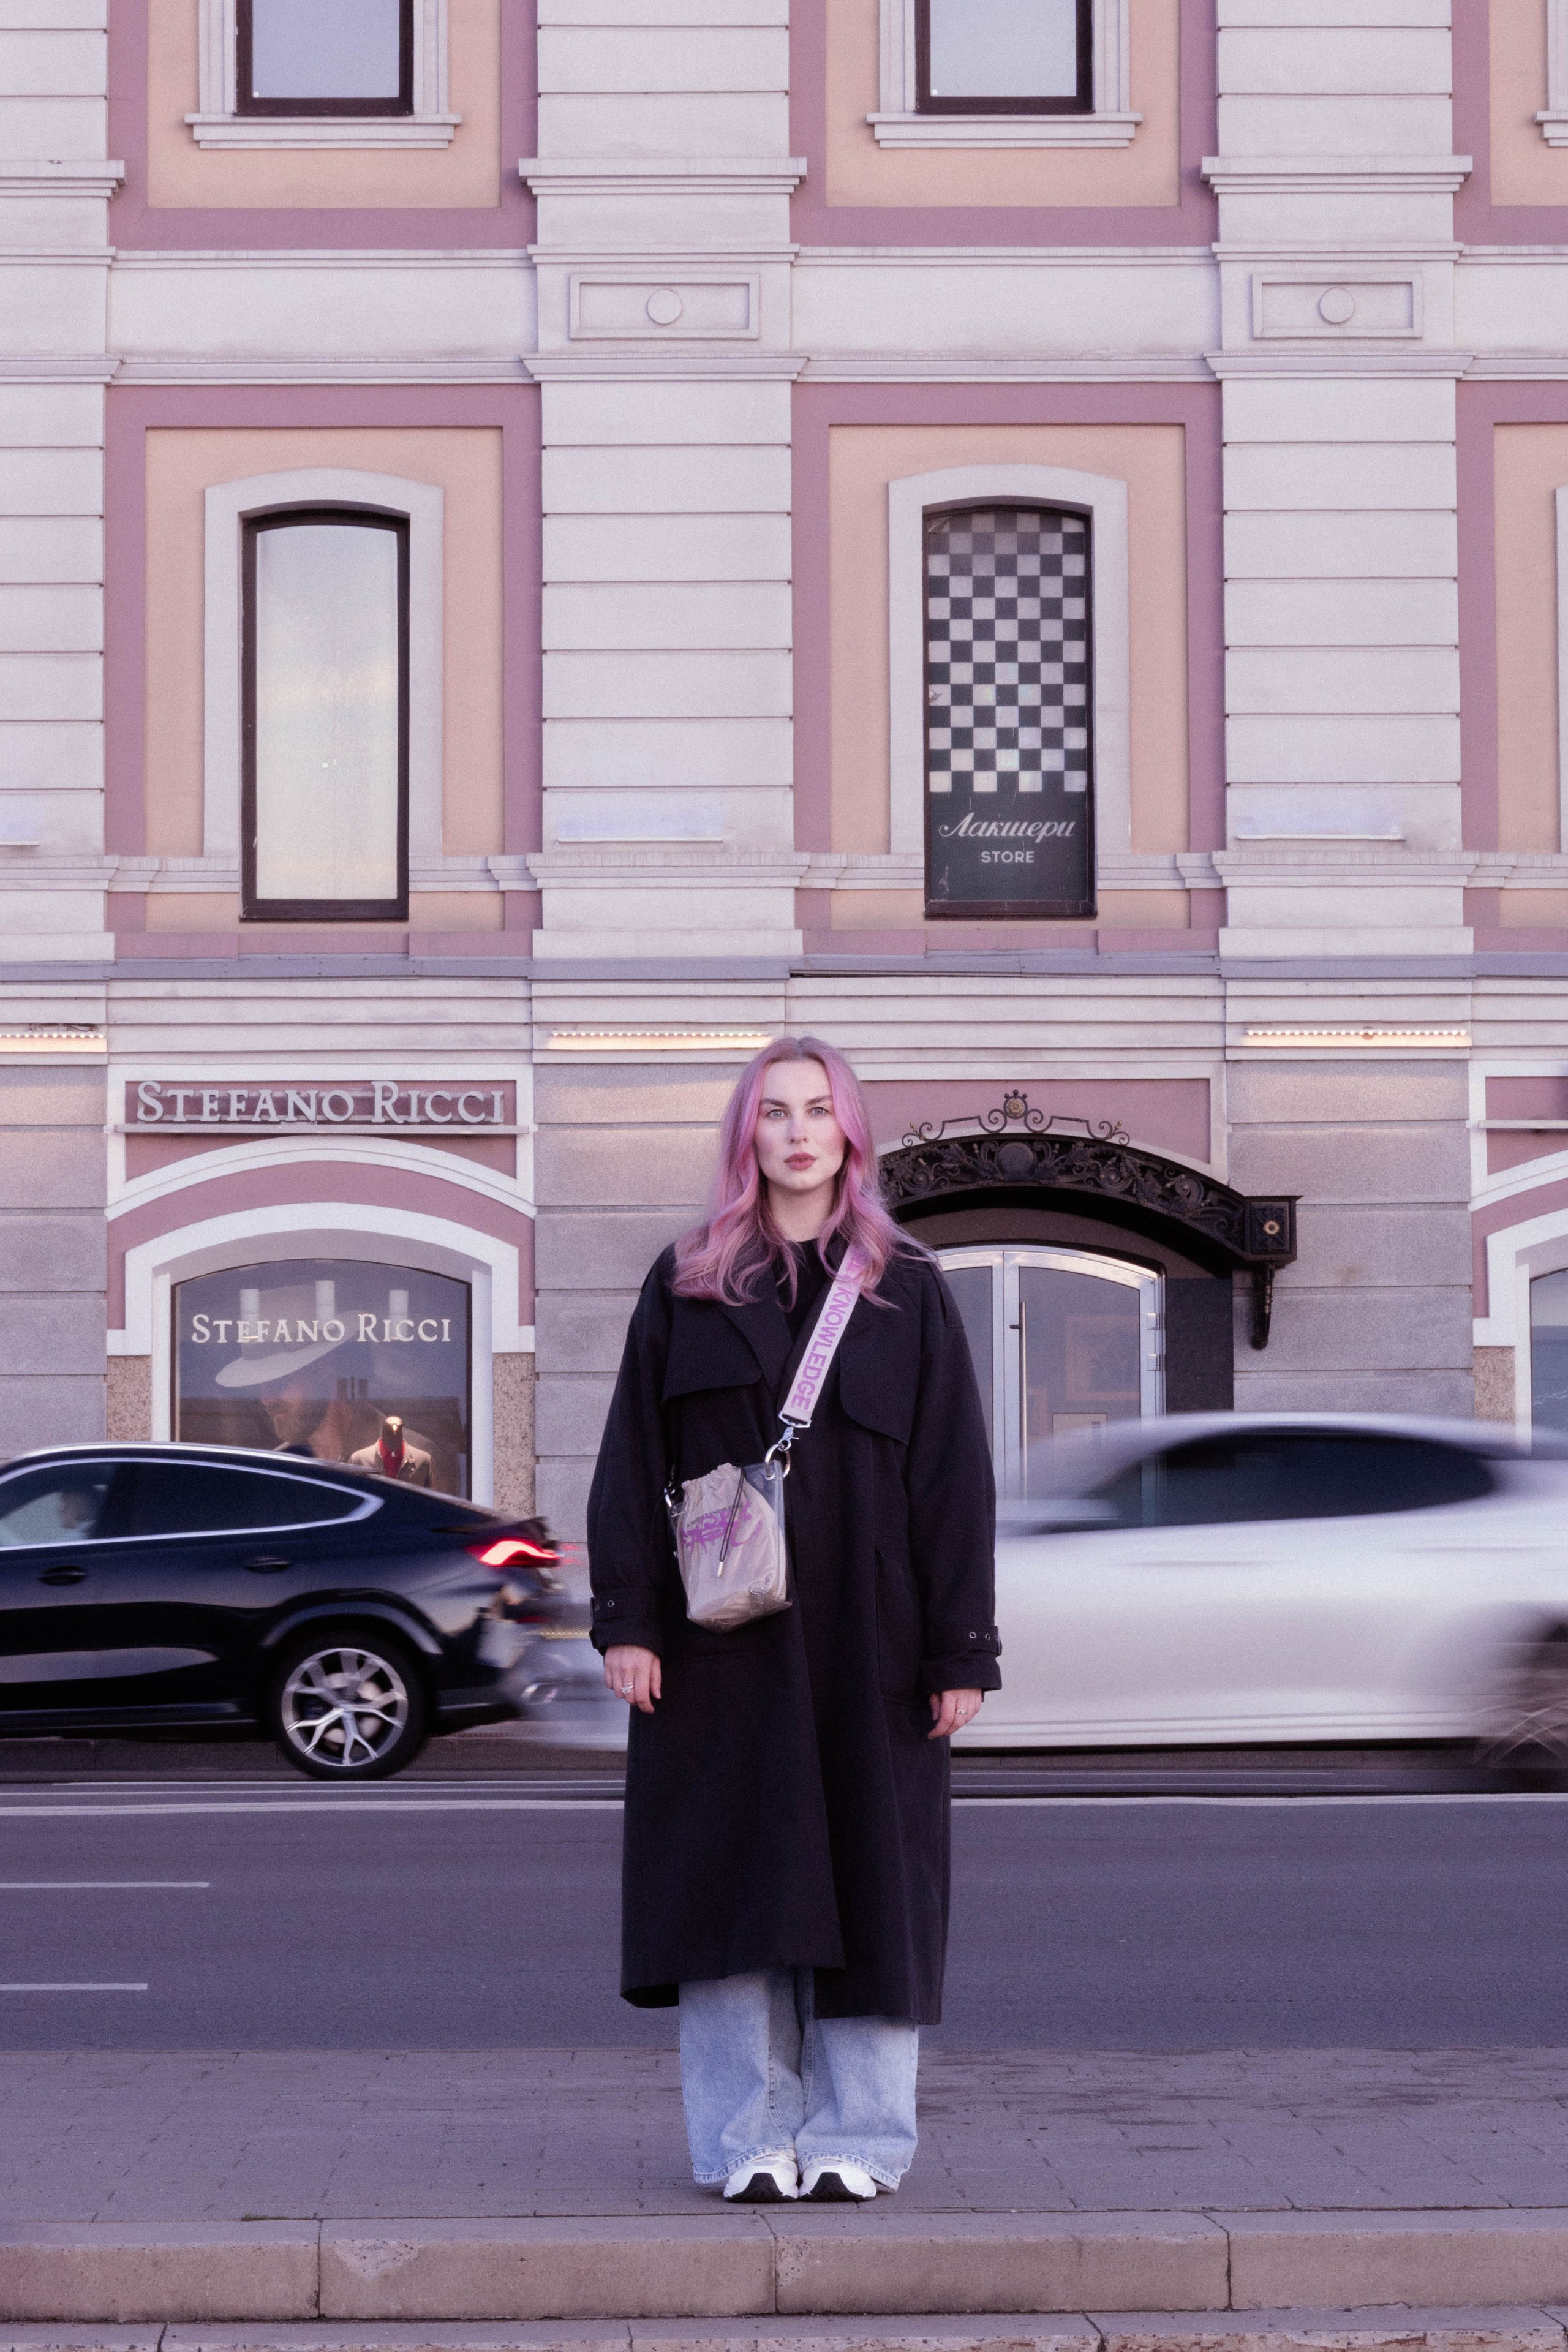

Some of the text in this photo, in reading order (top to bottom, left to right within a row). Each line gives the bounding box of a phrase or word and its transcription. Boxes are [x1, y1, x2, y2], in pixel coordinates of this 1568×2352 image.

[938, 812, 1076, 843] Лакшери
[981, 851, 1035, 864] STORE
[137, 1080, 504, 1124] STEFANO RICCI
[191, 1313, 451, 1343] STEFANO RICCI
[791, 1286, 854, 1411] KNOWLEDGE
